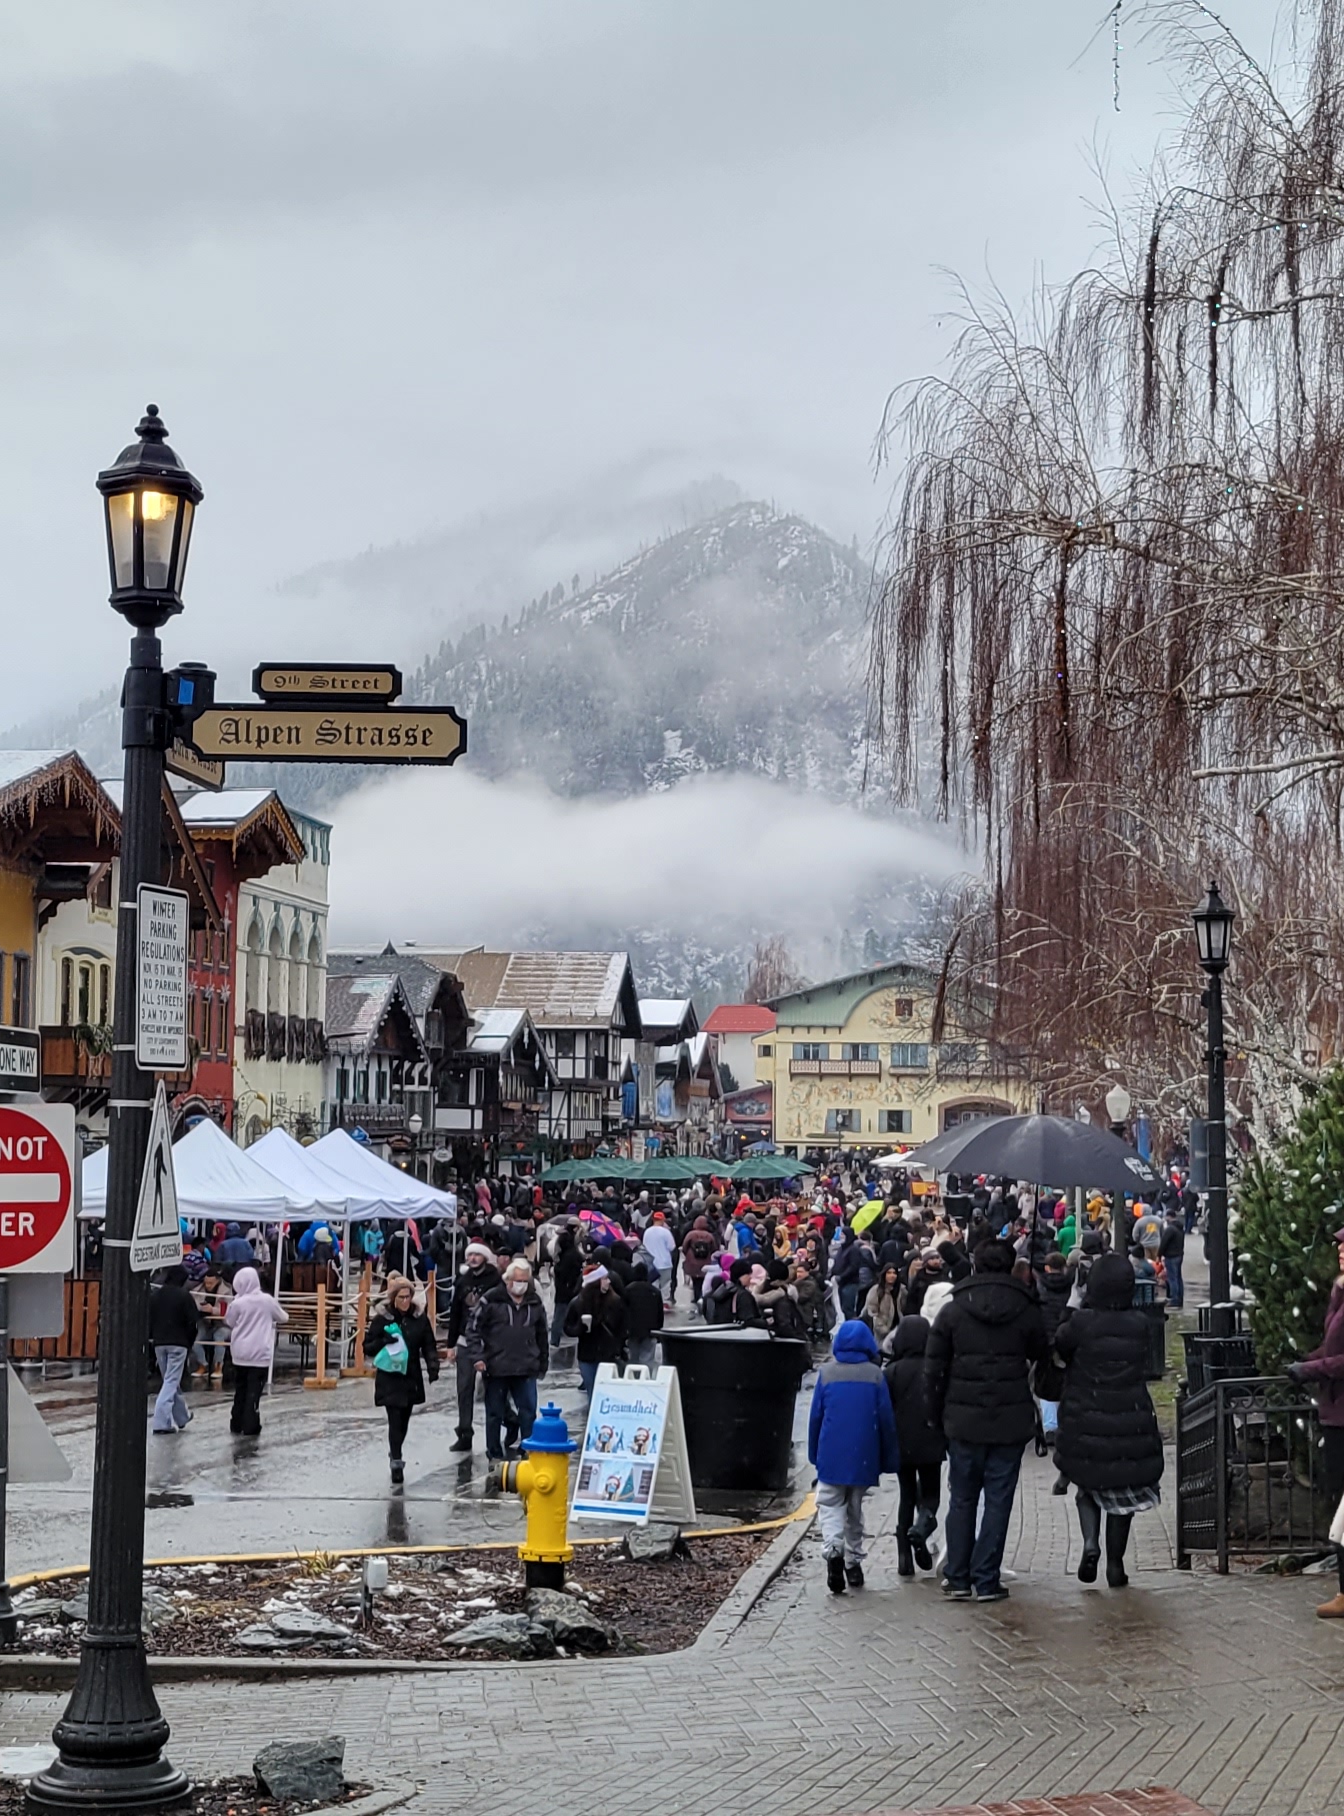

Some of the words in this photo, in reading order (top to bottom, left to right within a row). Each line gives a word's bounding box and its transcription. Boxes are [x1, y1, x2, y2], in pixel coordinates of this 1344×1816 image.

[273, 674, 301, 689] 9th
[308, 674, 380, 690] Street
[218, 716, 302, 750] Alpen
[314, 717, 434, 748] Strasse
[152, 899, 176, 920] WINTER
[149, 920, 177, 941] PARKING
[141, 940, 185, 963] REGULATIONS
[160, 964, 166, 976] TO
[177, 967, 183, 978] 15
[143, 978, 153, 990] NO
[154, 980, 182, 993] PARKING
[141, 993, 154, 1005] ALL
[157, 994, 183, 1008] STREETS
[141, 1009, 146, 1020] 3
[147, 1009, 157, 1020] AM
[159, 1010, 168, 1021] TO
[169, 1011, 174, 1022] 7
[175, 1011, 184, 1022] AM
[18, 1047, 37, 1074] WAY
[133, 1242, 160, 1264] PEDESTRIAN
[160, 1242, 181, 1260] CROSSING
[598, 1397, 659, 1417] Gesundheit
